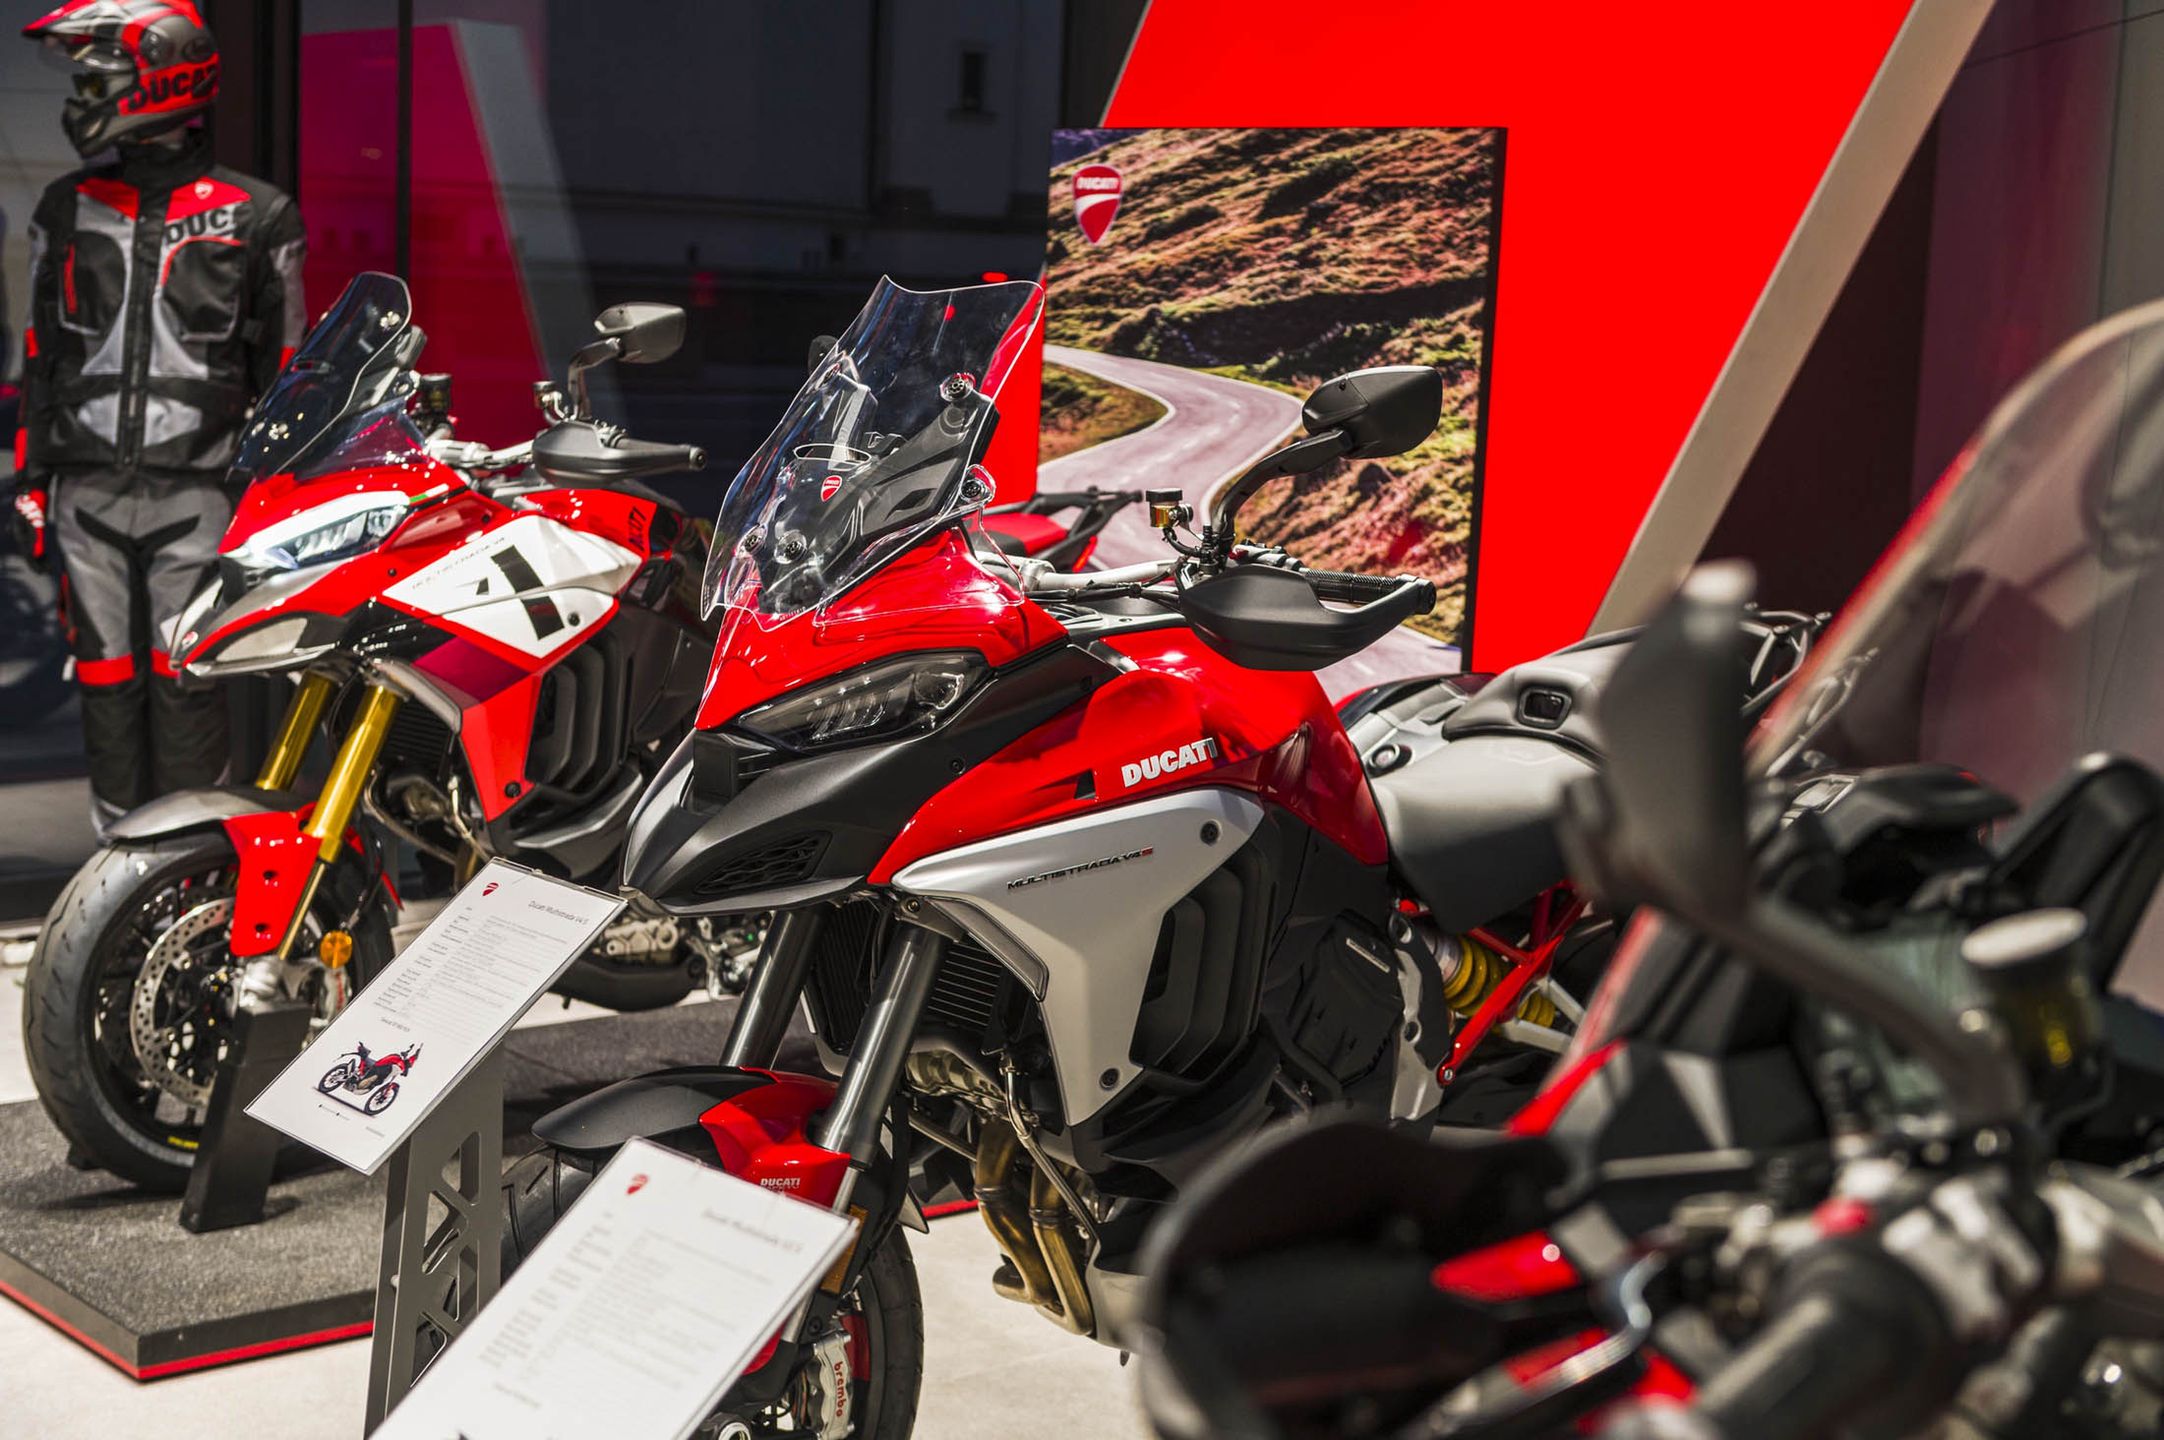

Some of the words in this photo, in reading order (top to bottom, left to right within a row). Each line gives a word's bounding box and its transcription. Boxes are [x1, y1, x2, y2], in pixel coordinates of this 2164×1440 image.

[1121, 737, 1218, 788] DUCATI
[1007, 856, 1121, 890] MULTISTRADA
[760, 1177, 801, 1187] DUCATI
[834, 1361, 847, 1417] brembo
